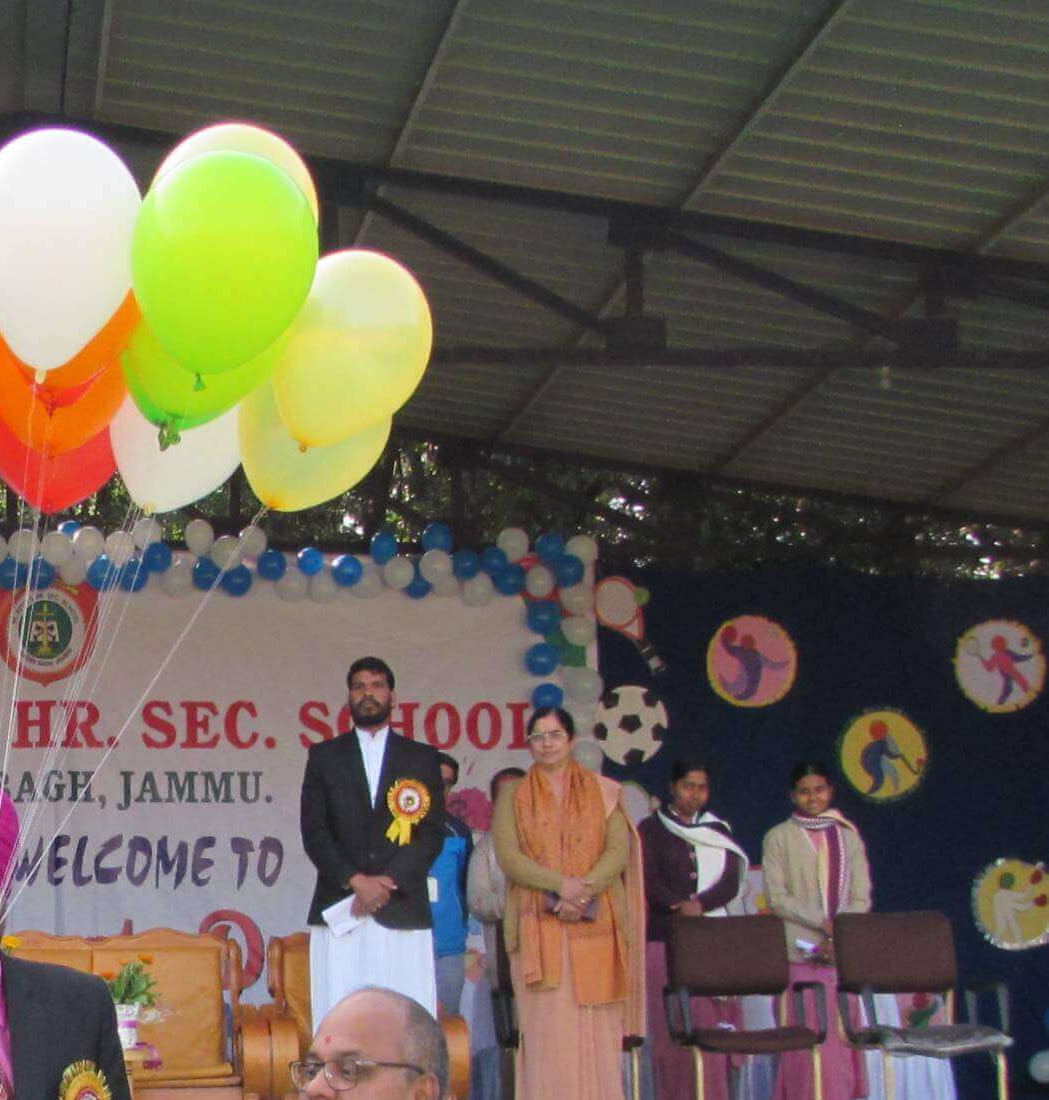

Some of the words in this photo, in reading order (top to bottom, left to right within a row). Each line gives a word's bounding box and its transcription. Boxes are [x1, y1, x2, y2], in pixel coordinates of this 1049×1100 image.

[11, 699, 119, 749] HR.
[141, 699, 276, 749] SEC.
[117, 771, 273, 810] JAMMU.
[13, 834, 216, 890] WELCOME
[230, 836, 283, 890] TO
